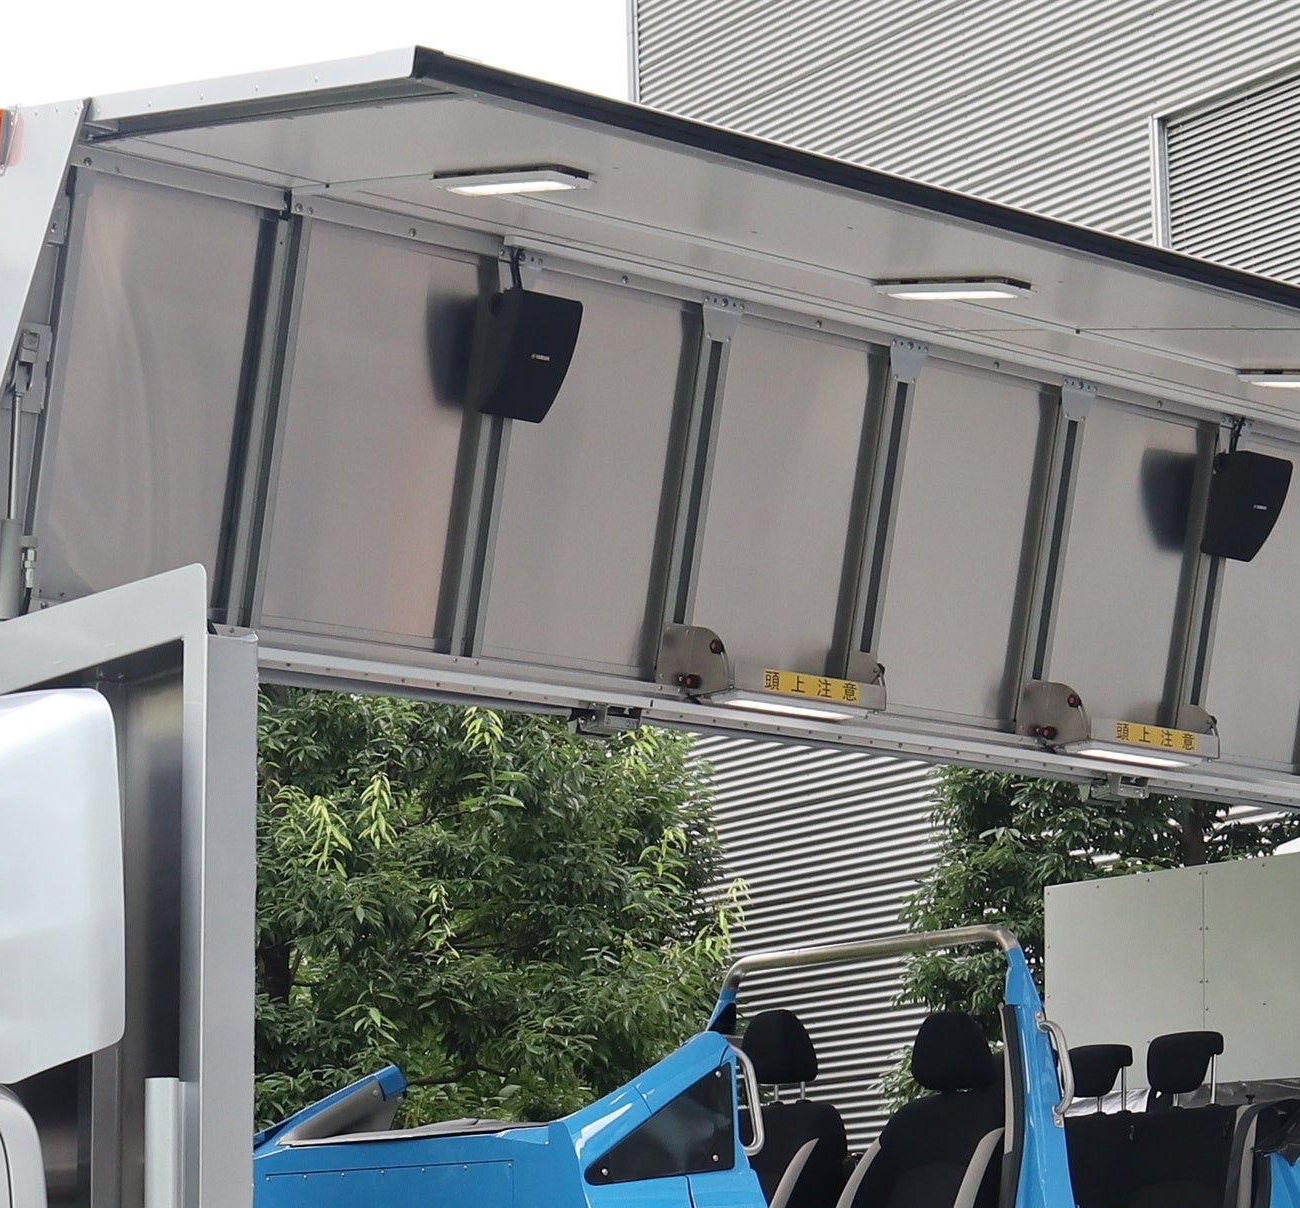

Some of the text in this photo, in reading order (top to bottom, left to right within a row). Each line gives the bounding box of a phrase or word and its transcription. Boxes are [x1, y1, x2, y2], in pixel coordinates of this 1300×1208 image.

[764, 670, 858, 702] 頭上注意
[1115, 722, 1196, 751] 頭上注意
